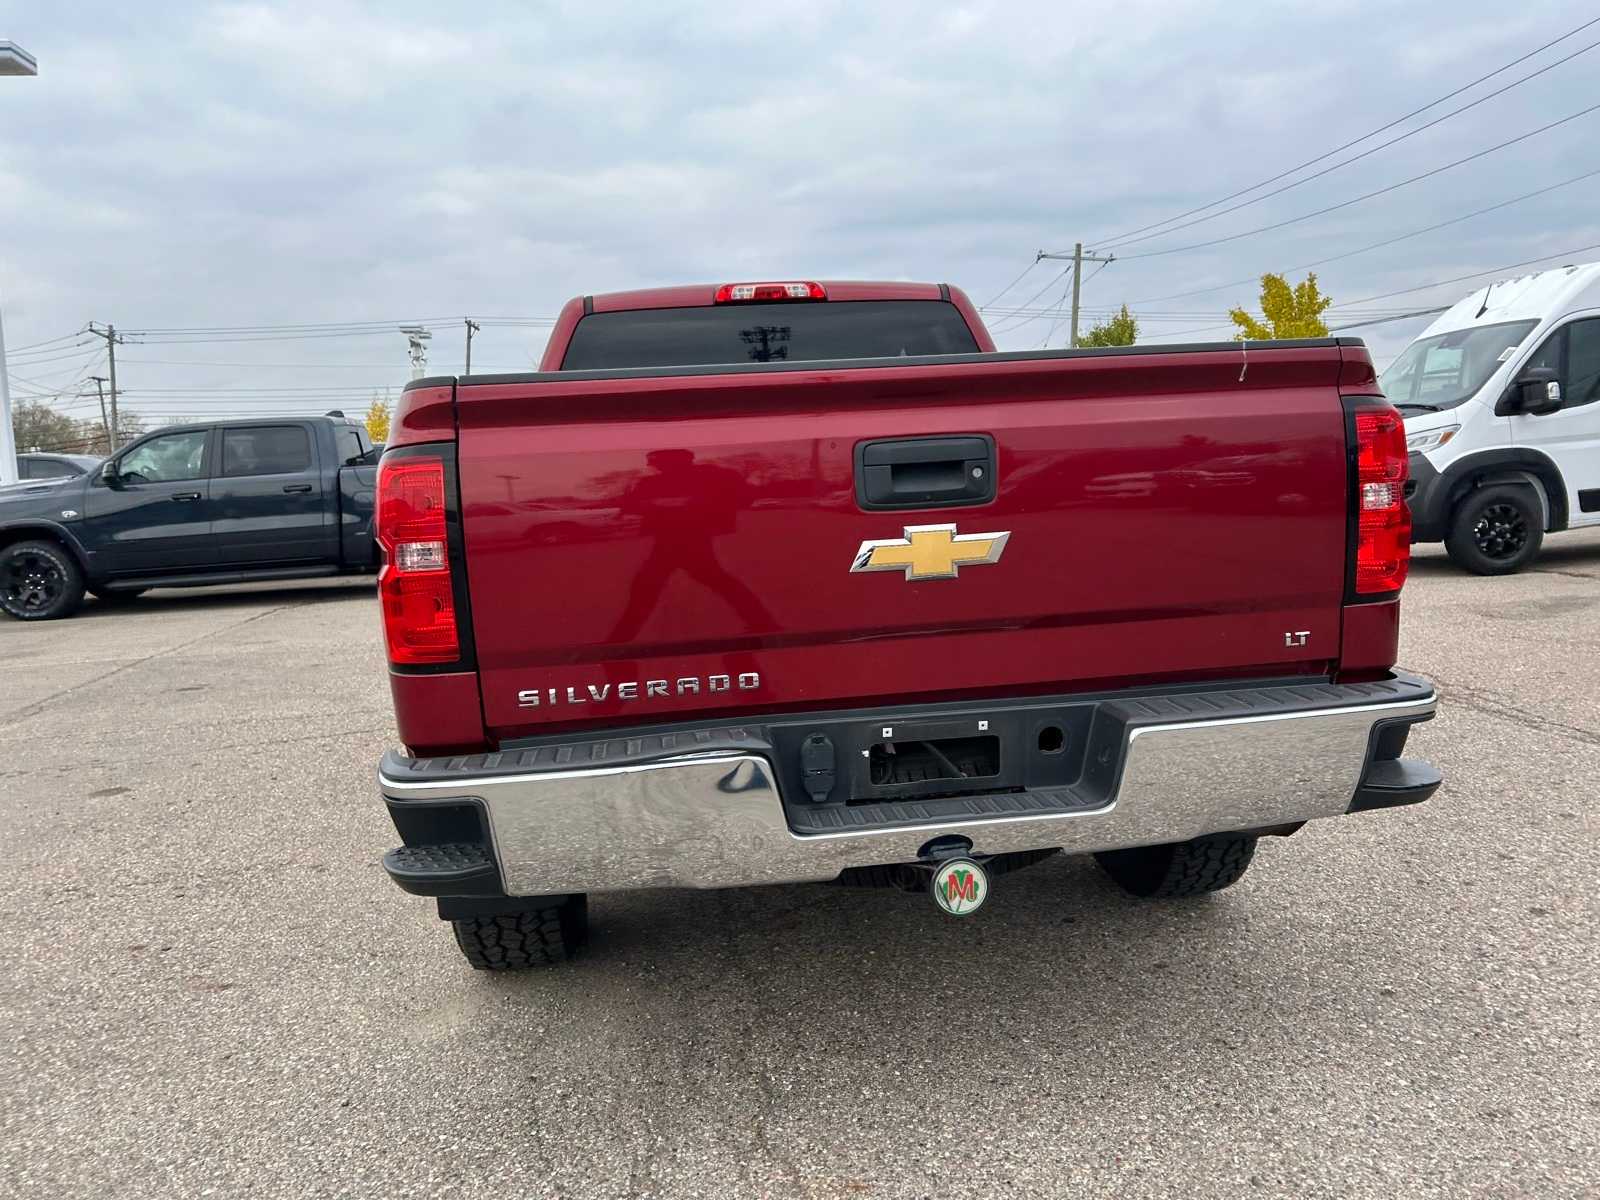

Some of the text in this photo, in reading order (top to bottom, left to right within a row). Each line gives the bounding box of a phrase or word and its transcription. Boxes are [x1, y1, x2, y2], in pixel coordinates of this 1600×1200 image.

[1285, 631, 1311, 647] LT
[518, 672, 760, 708] SILVERADO
[948, 873, 976, 901] M
